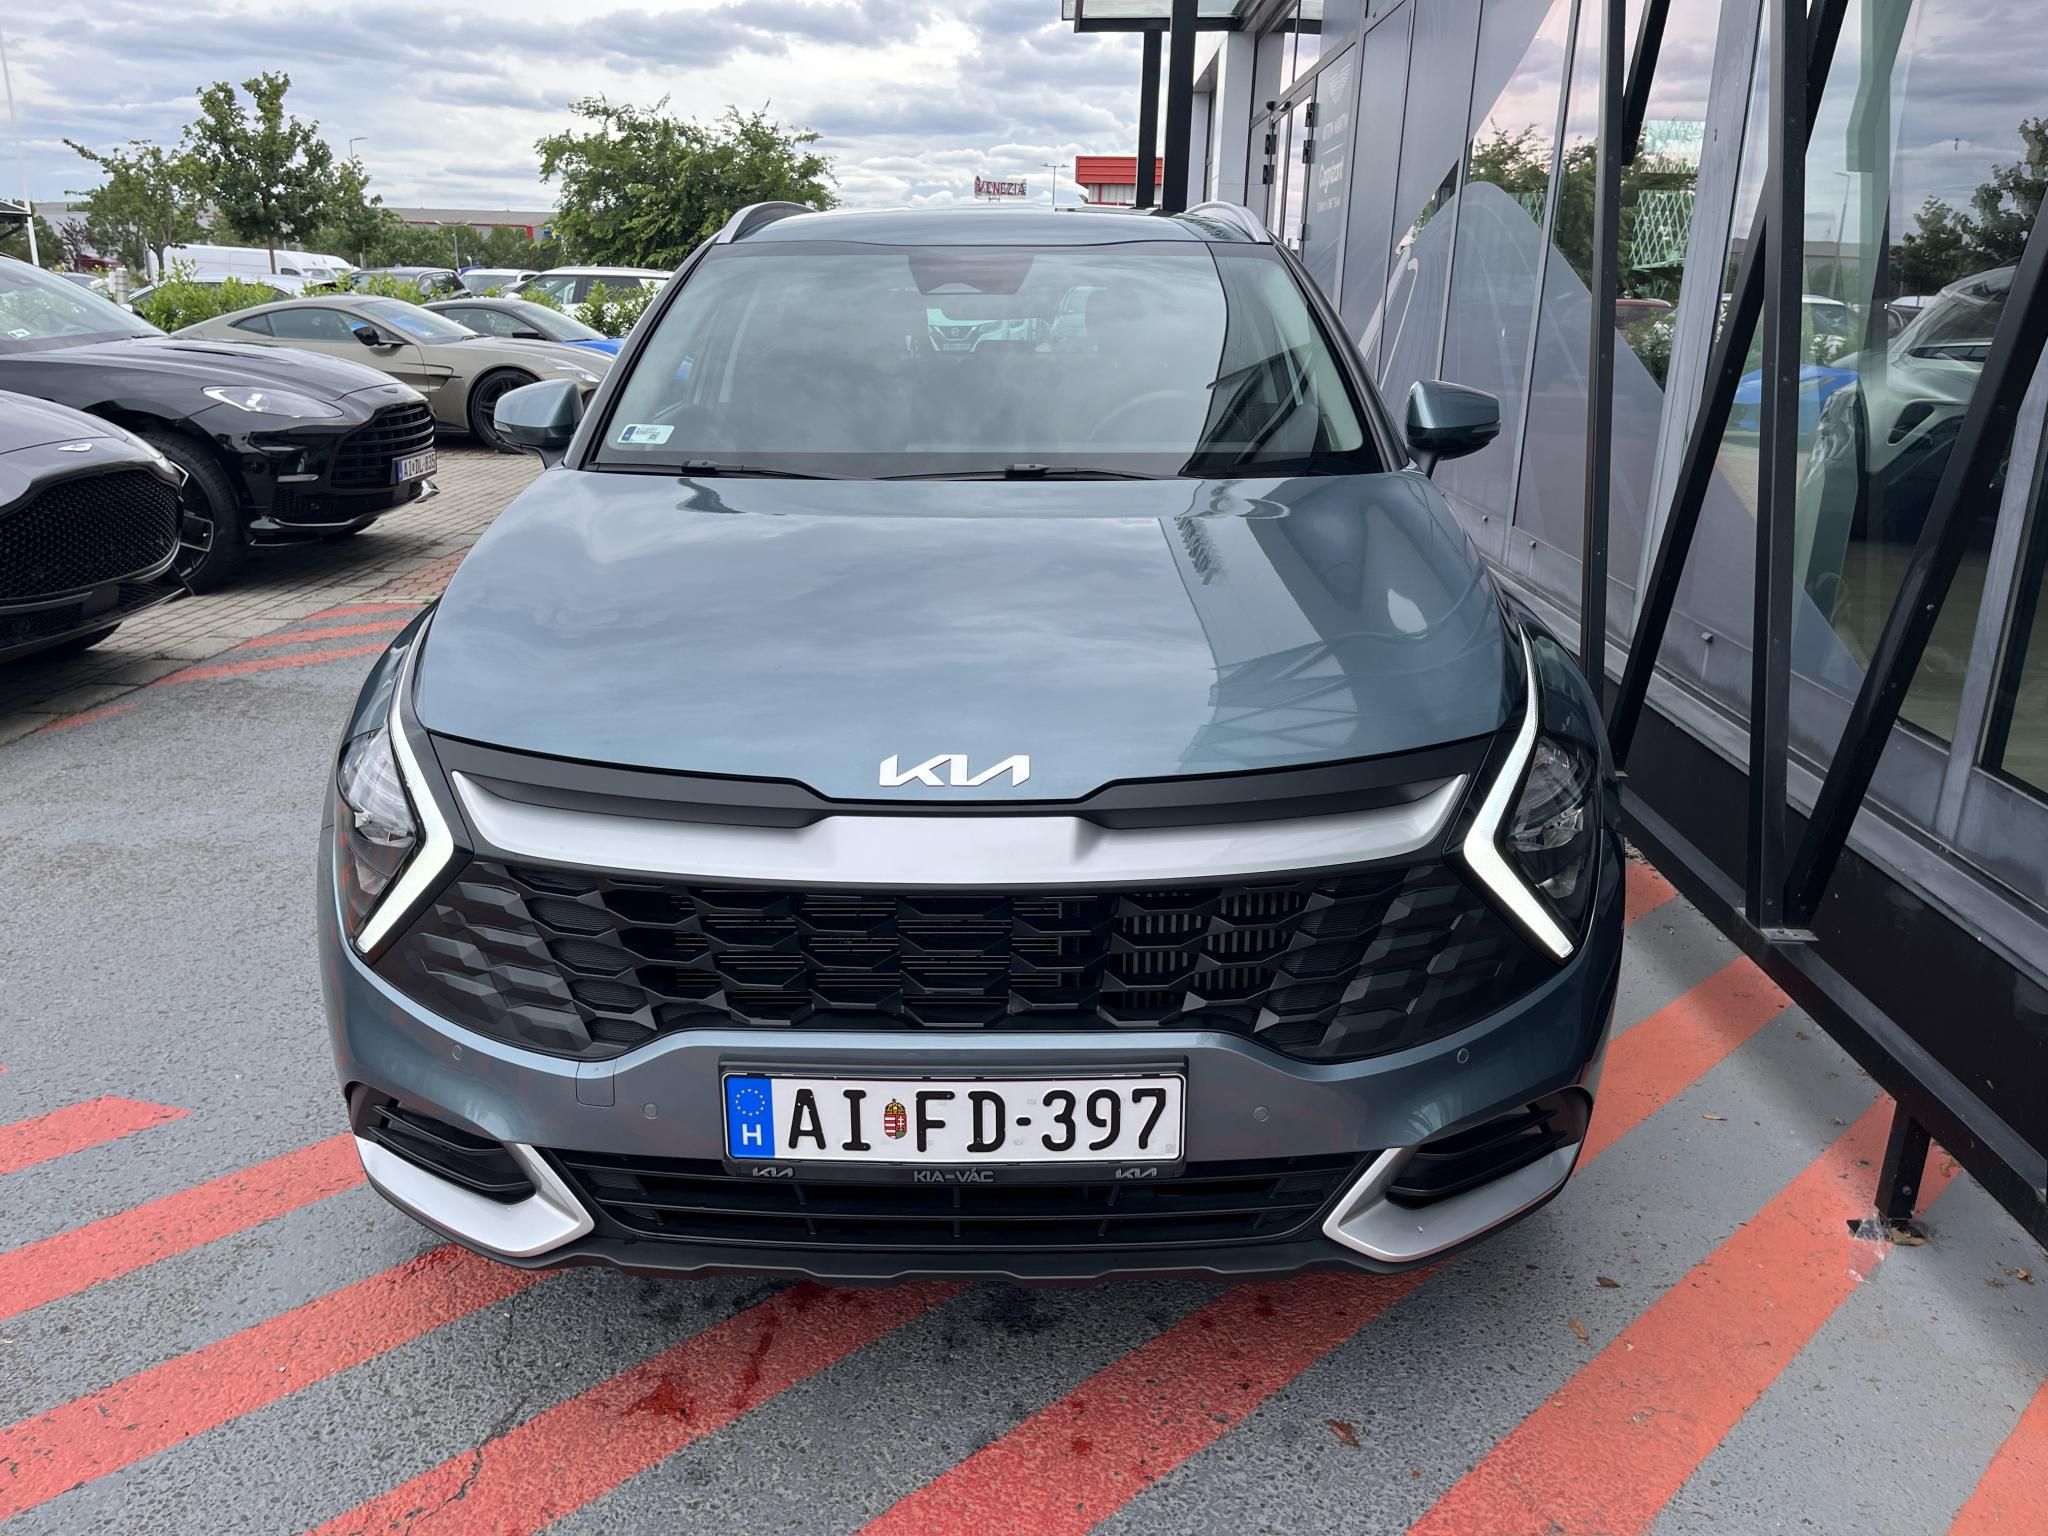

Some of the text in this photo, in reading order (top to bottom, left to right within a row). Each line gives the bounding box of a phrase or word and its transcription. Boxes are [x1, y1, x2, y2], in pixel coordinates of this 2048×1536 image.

[975, 176, 1026, 196] VENEZIA
[879, 753, 1030, 787] KIA
[788, 1088, 1167, 1153] AI FD-397
[742, 1123, 762, 1146] H
[752, 1167, 794, 1178] KIA
[913, 1166, 994, 1183] KIA-VÁC
[1115, 1167, 1157, 1179] KIA
